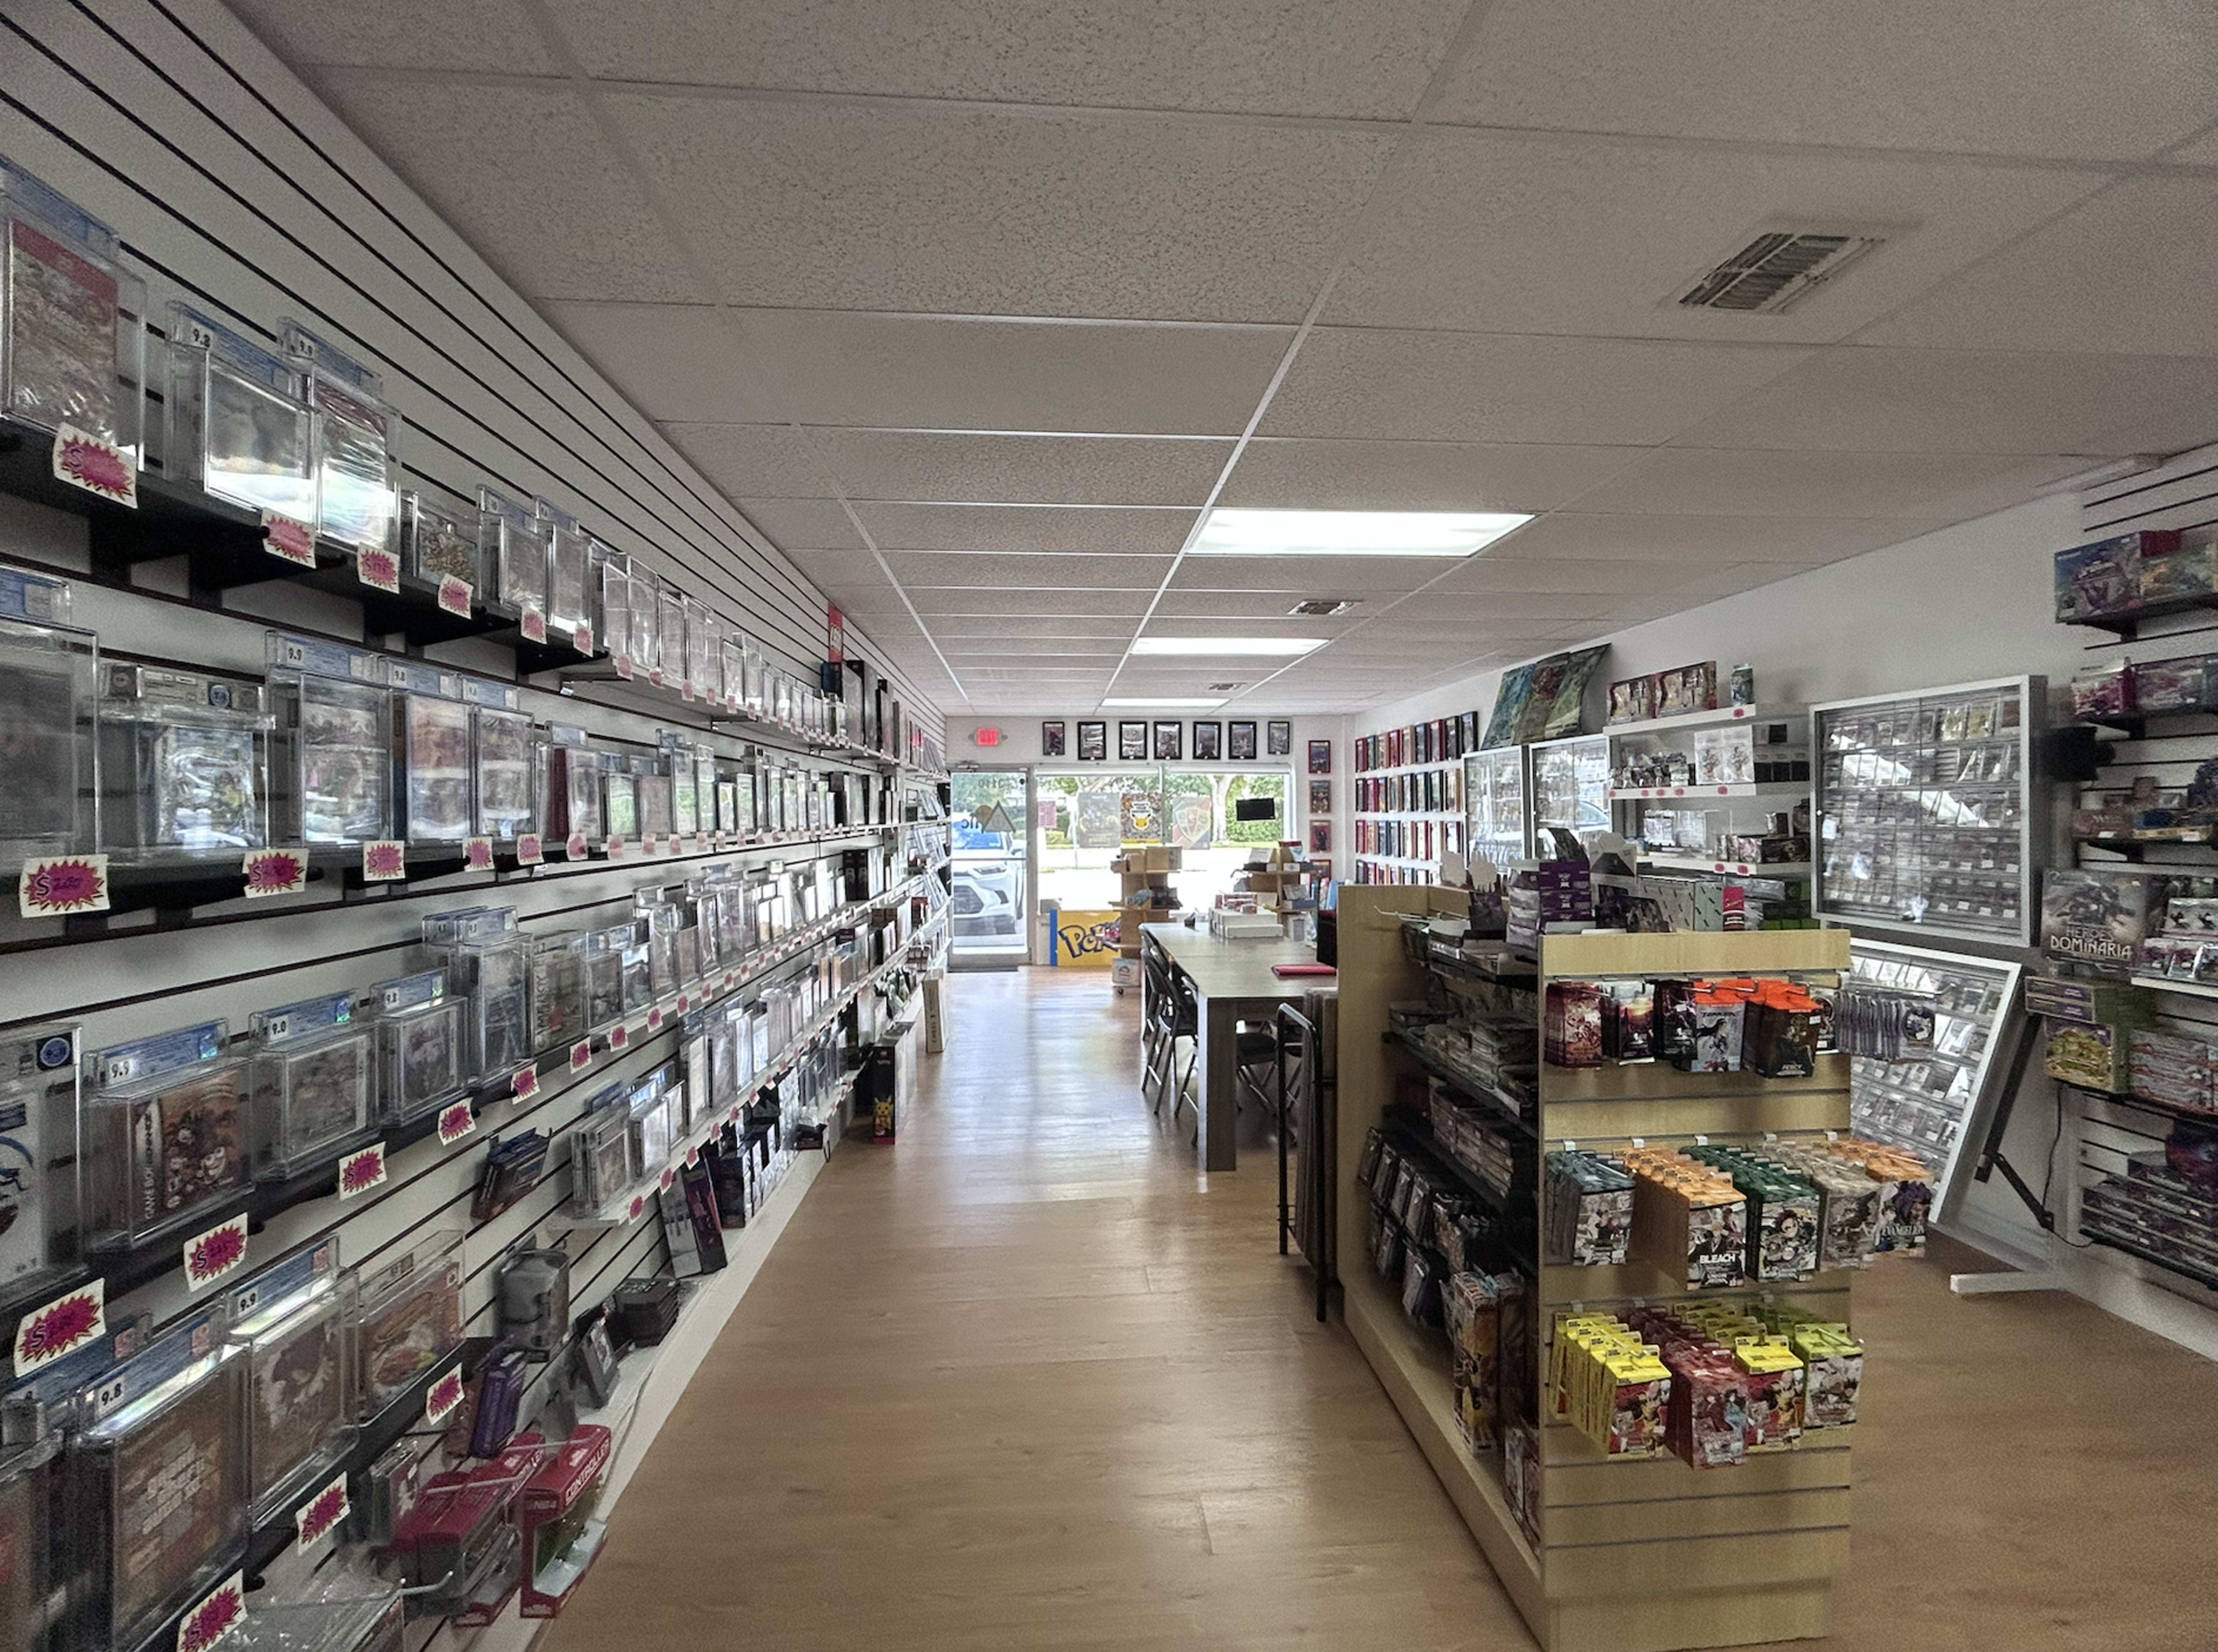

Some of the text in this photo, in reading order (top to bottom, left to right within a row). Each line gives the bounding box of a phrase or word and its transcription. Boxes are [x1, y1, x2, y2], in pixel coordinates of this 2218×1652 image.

[978, 729, 999, 743] EXIT
[2066, 925, 2114, 942] HEROES
[2050, 935, 2131, 959] DOMINARIA
[1700, 1253, 1736, 1264] BLEACH
[240, 1293, 256, 1311] 9.9
[101, 1383, 122, 1405] 9.8
